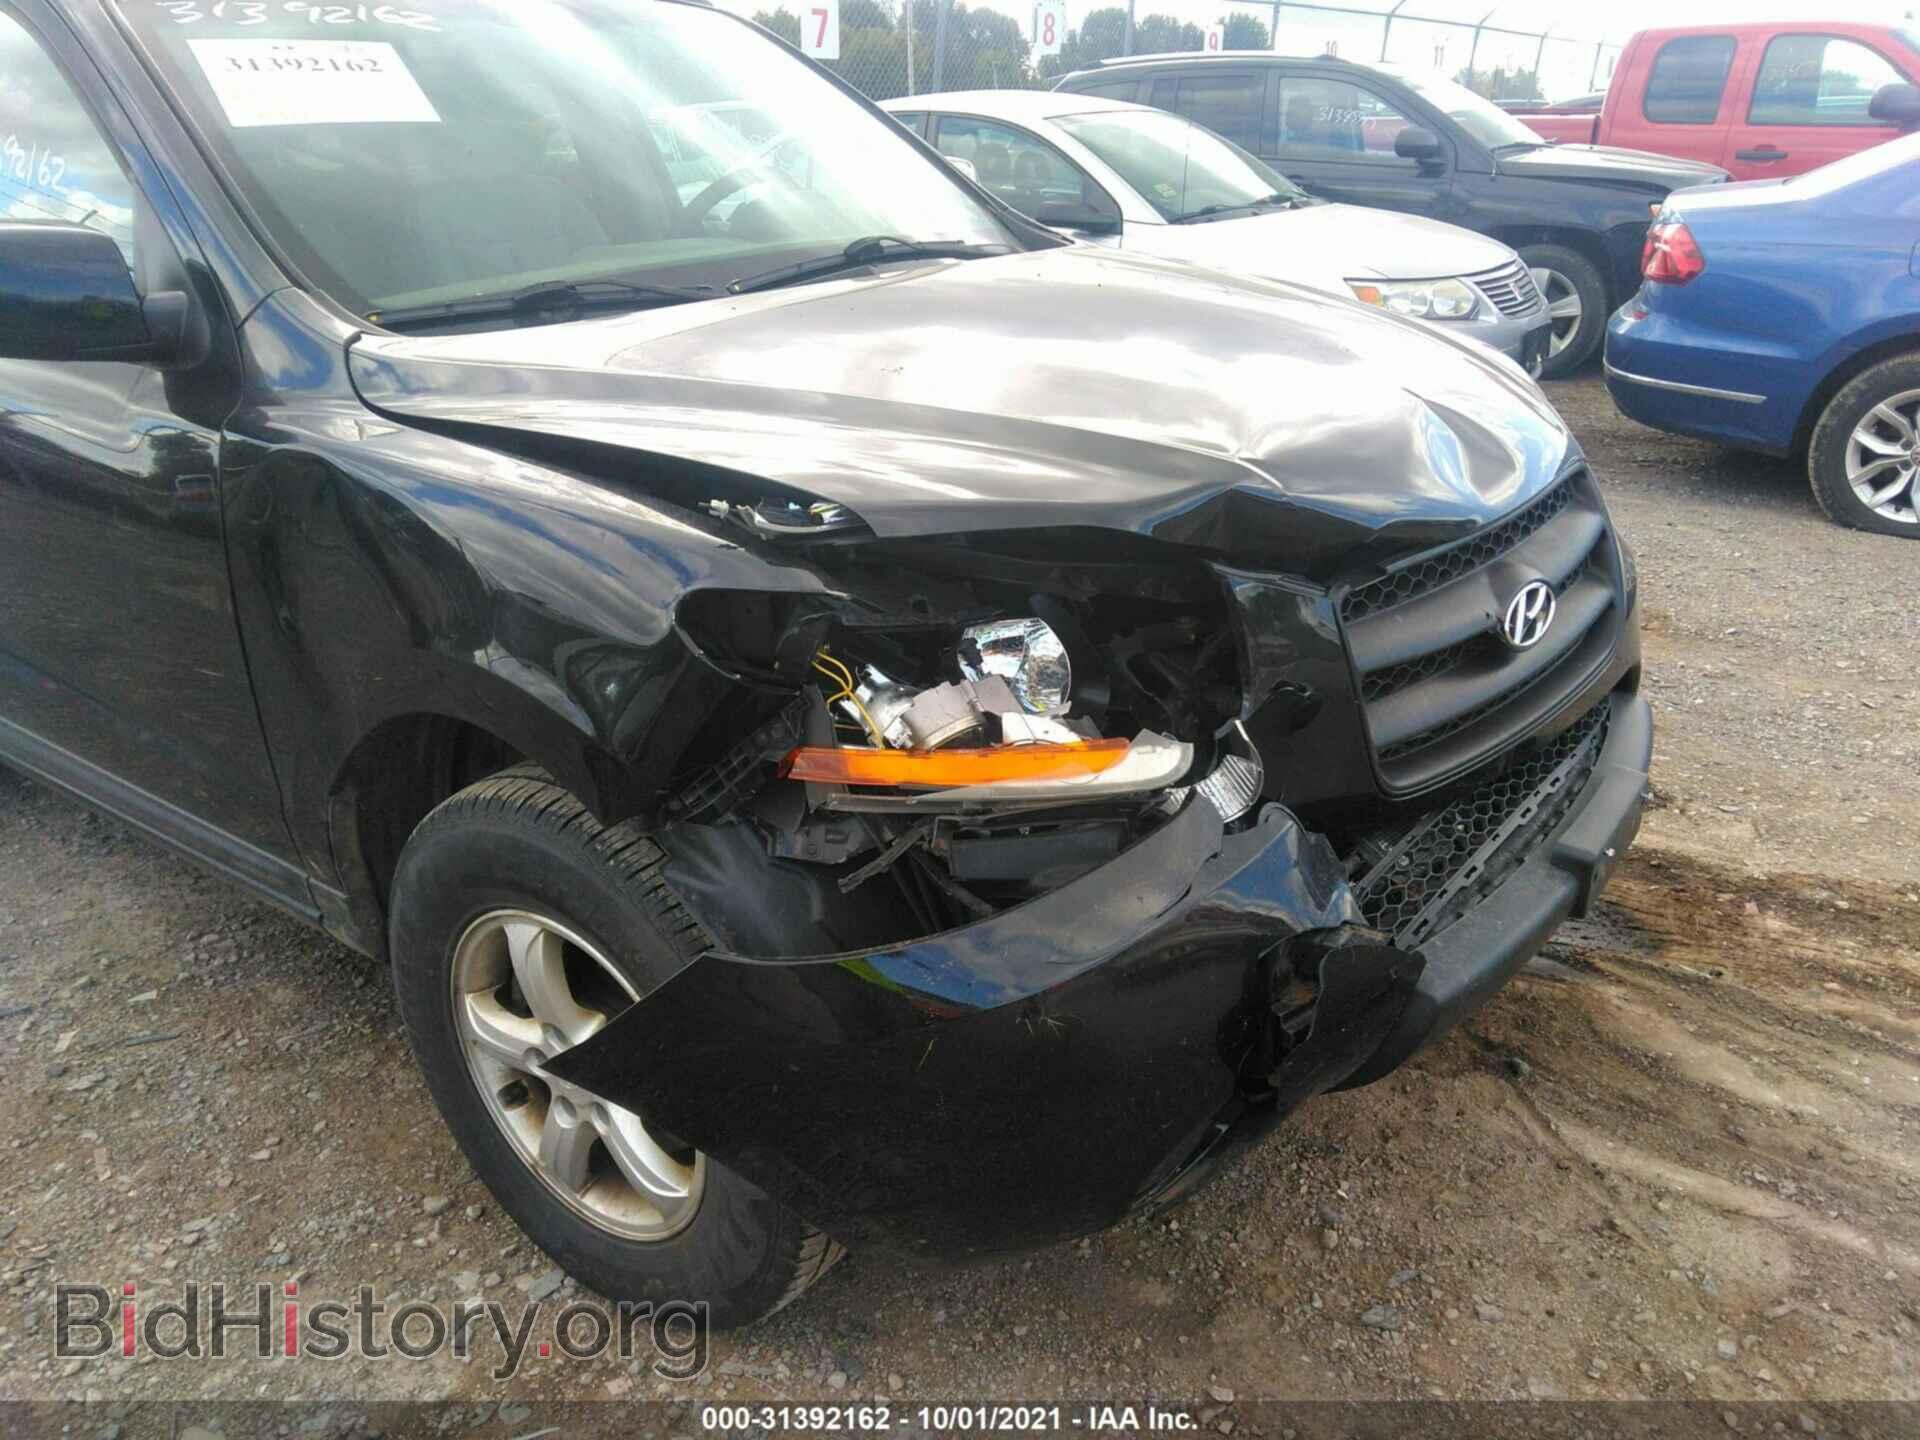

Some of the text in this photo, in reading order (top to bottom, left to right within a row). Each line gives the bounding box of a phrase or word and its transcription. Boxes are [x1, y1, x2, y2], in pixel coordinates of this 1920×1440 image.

[811, 8, 829, 49] 7
[1043, 12, 1056, 46] 8
[1209, 31, 1218, 52] 9
[225, 56, 384, 73] 31392162
